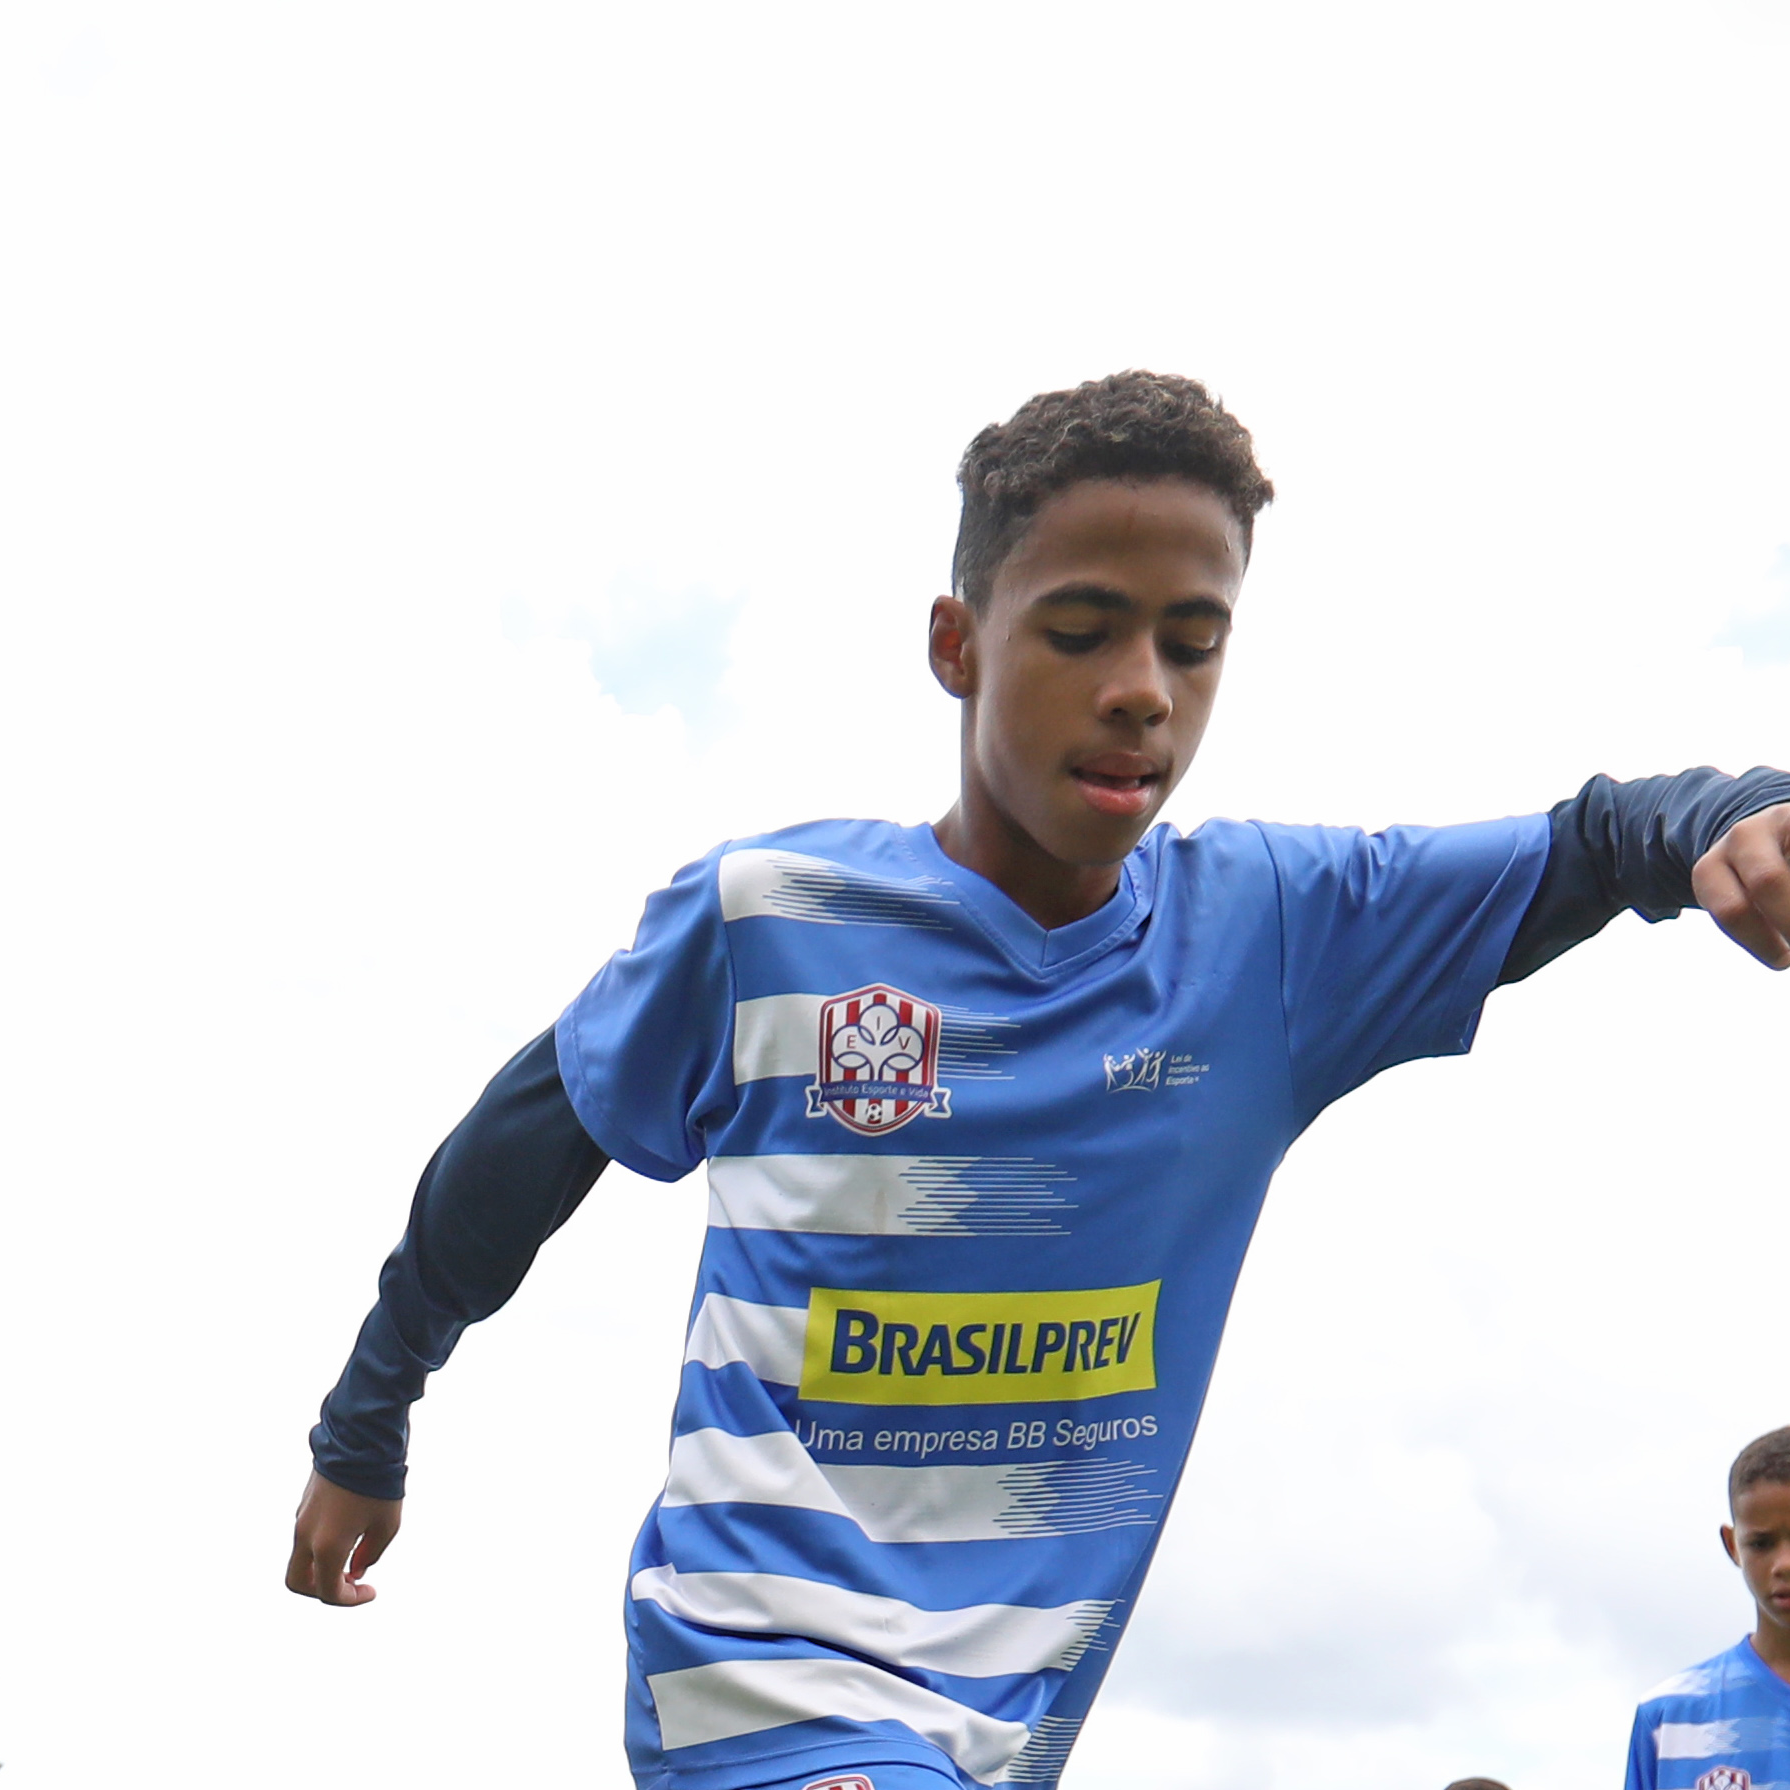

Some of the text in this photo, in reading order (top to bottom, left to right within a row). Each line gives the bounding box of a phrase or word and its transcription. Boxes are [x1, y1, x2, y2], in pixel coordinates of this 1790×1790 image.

[861, 1083, 898, 1096] Esporte
[909, 1087, 929, 1098] Vida
[829, 1308, 1143, 1376] BRASILPREV
[794, 1415, 1159, 1460] Uma empresa BB Seguros
